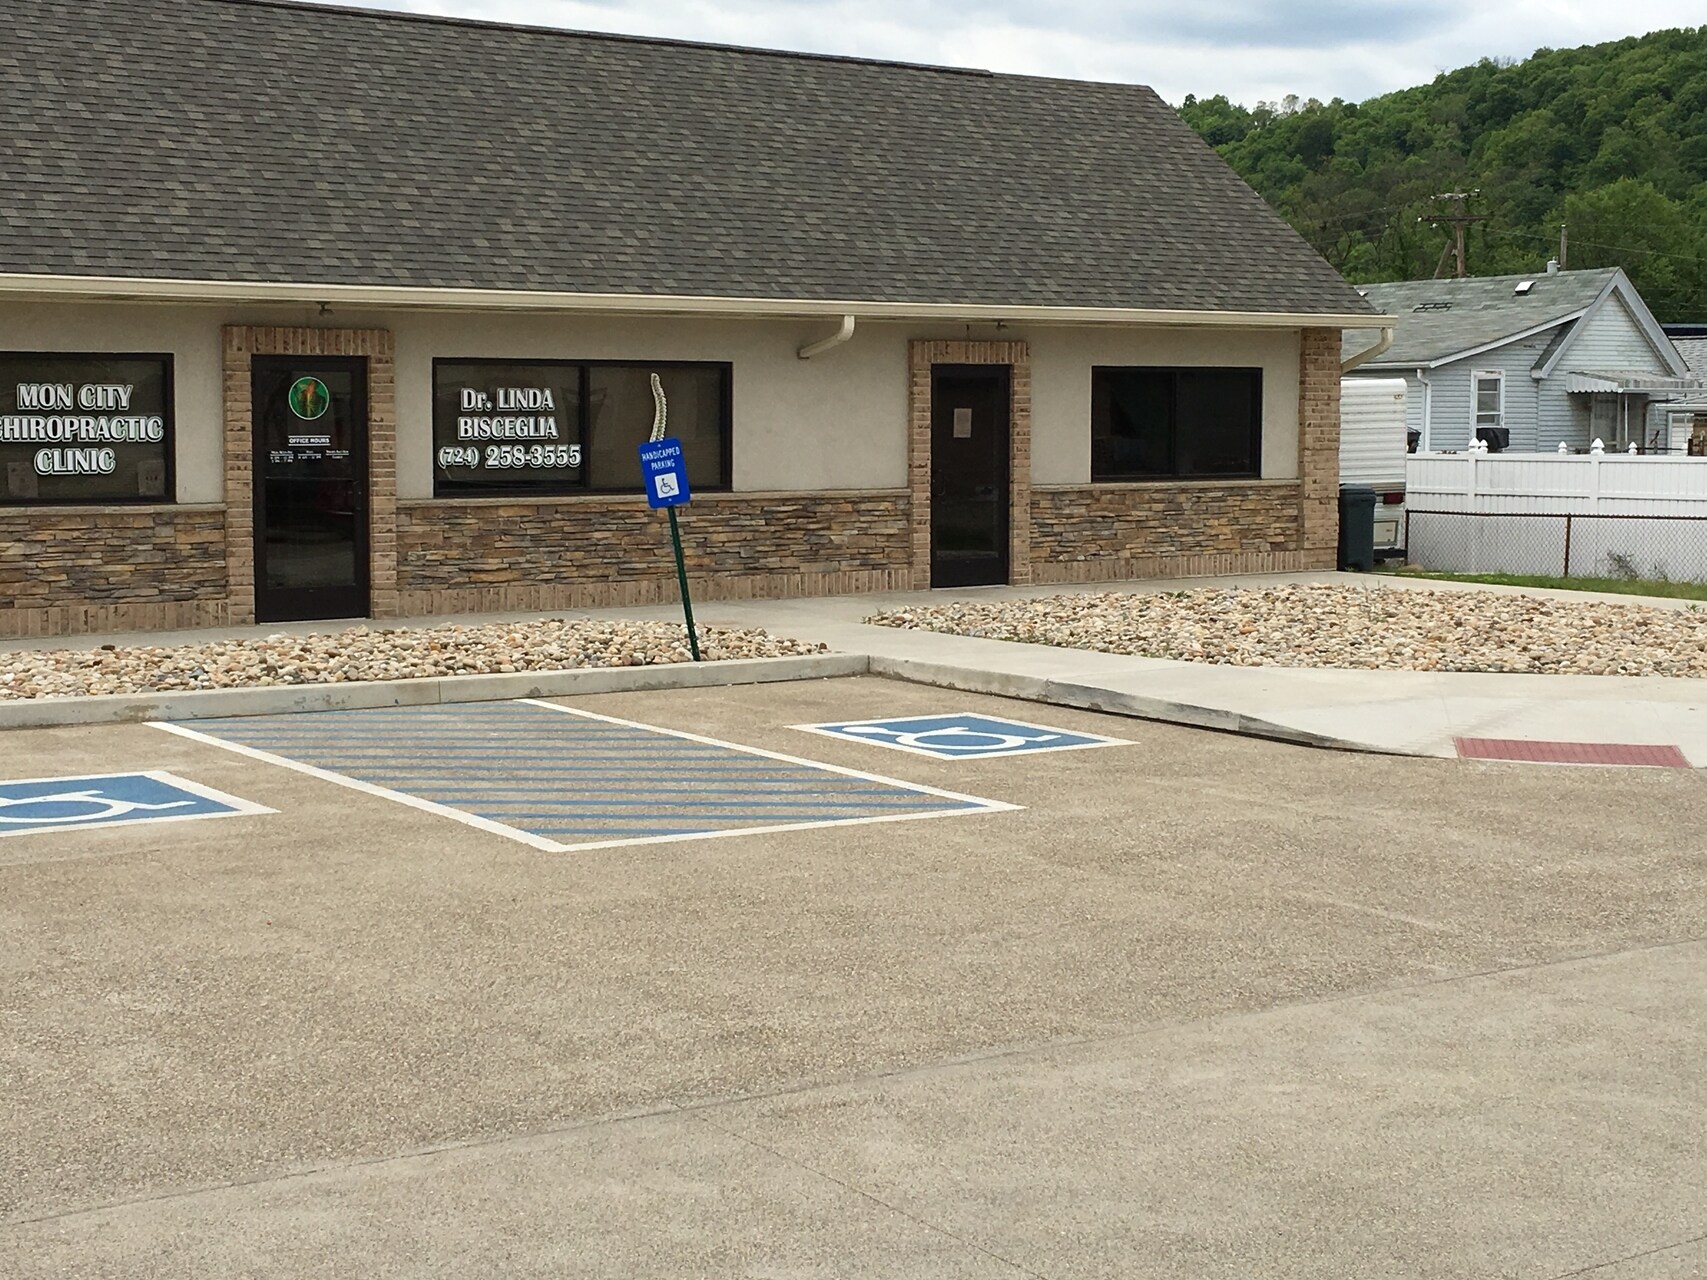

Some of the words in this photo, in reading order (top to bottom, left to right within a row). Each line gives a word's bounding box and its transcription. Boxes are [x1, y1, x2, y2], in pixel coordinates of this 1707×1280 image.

[17, 383, 73, 410] MON
[78, 383, 133, 410] CITY
[461, 388, 493, 411] Dr.
[497, 388, 555, 411] LINDA
[458, 416, 559, 440] BISCEGLIA
[34, 448, 116, 475] CLINIC
[438, 446, 480, 469] (724)
[485, 444, 581, 469] 258-3555
[642, 446, 681, 461] HANDICAPPED
[651, 459, 675, 470] PARKING
